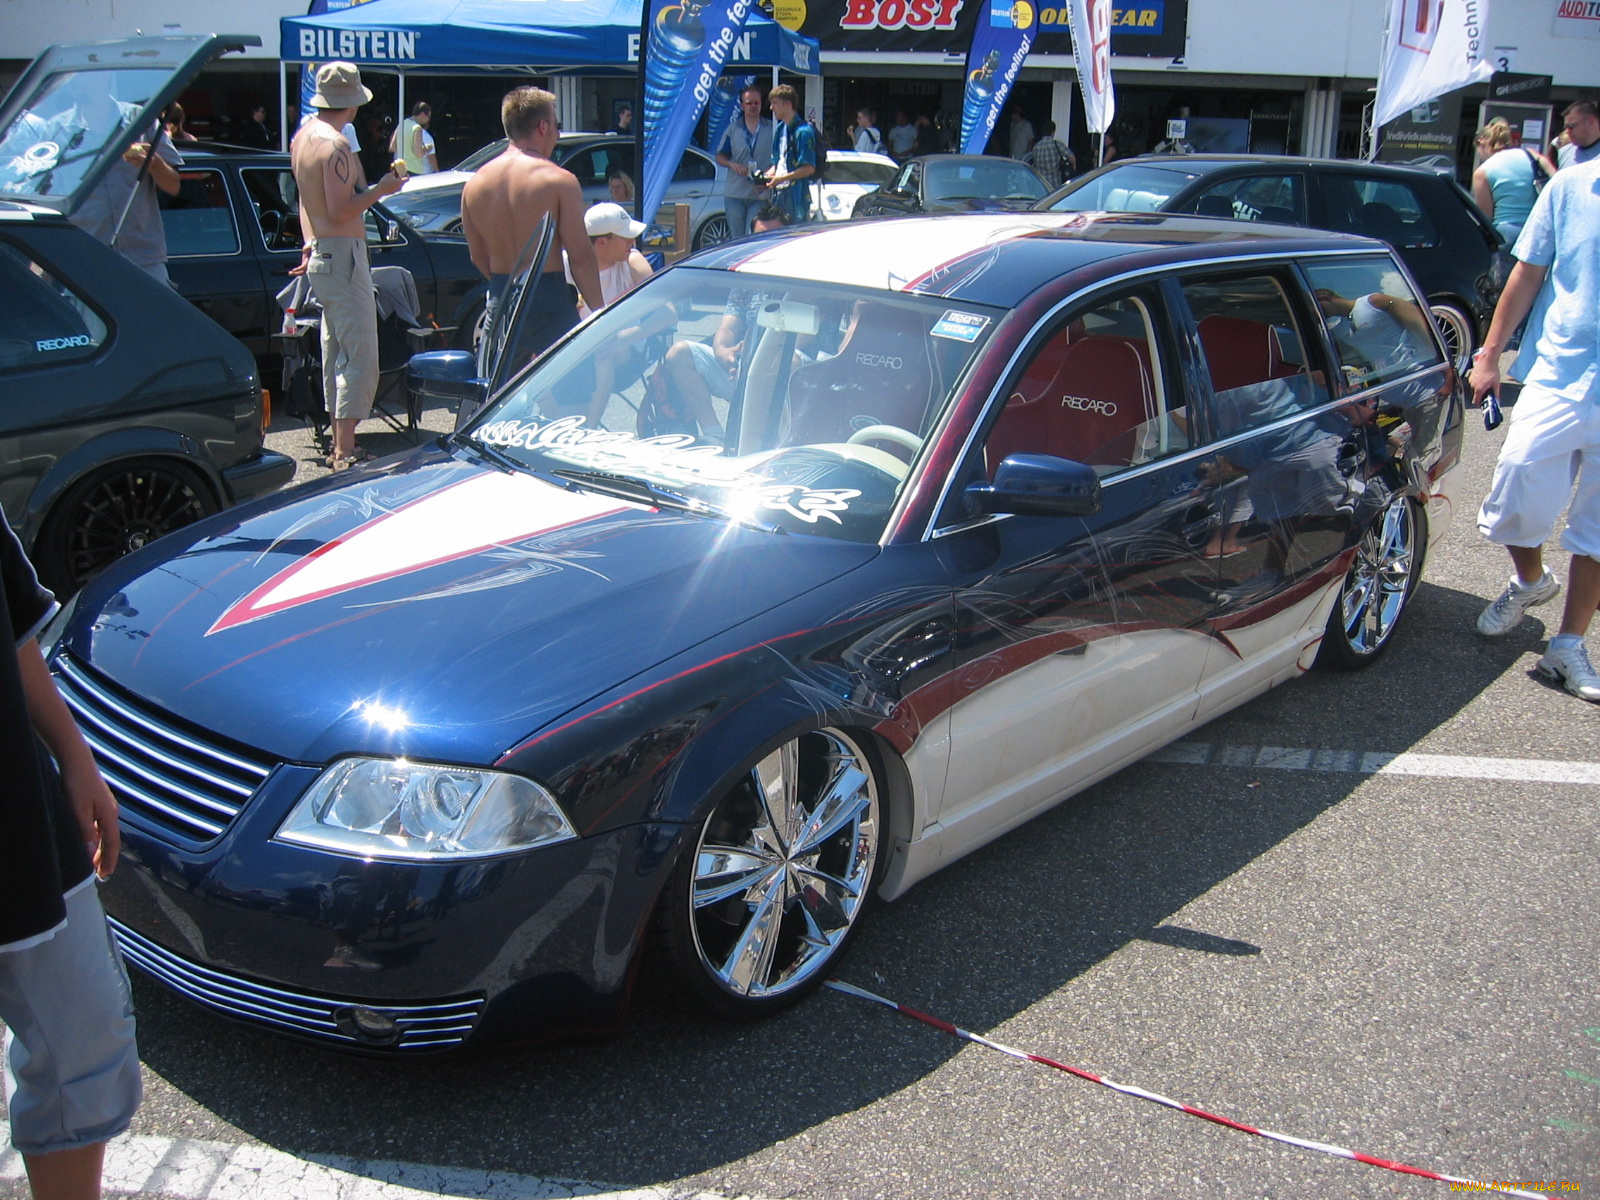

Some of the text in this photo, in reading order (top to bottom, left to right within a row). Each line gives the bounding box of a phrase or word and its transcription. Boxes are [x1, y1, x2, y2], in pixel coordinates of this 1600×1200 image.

[300, 29, 416, 60] BILSTEIN
[708, 27, 734, 65] the
[994, 83, 1009, 105] the
[1004, 33, 1031, 83] feeling!
[1498, 57, 1508, 72] 3
[36, 334, 90, 351] RECARO
[855, 352, 903, 370] RECARO
[1061, 395, 1118, 416] RECARO
